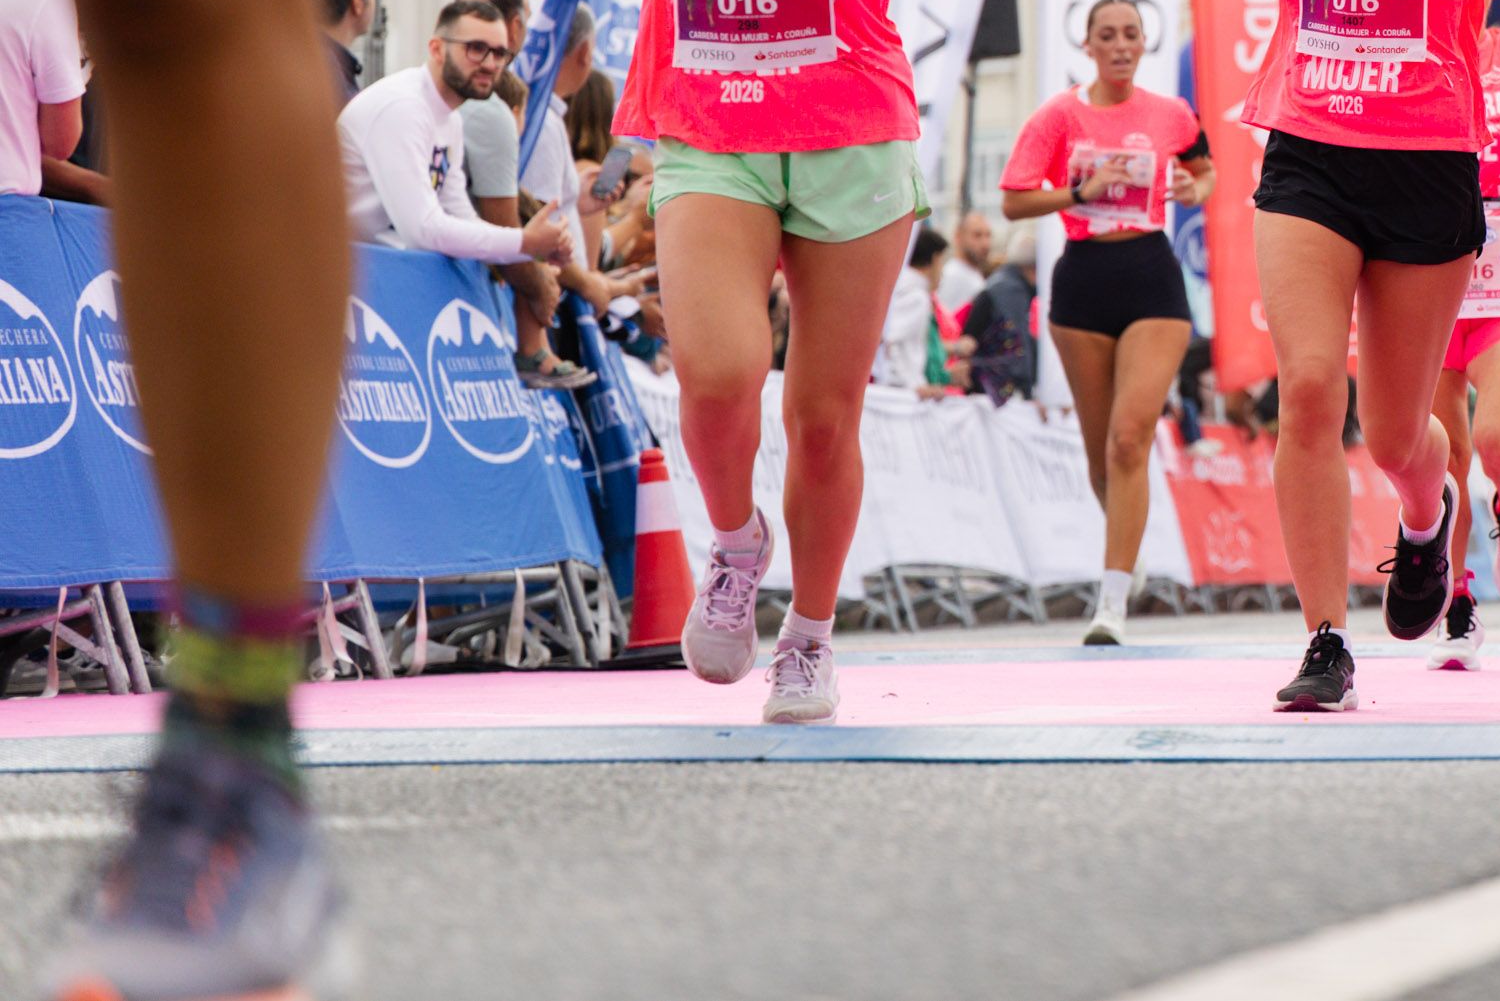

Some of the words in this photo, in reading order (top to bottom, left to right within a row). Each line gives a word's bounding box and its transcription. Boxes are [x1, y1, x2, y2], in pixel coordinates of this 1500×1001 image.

[738, 20, 760, 31] 298
[1341, 15, 1365, 26] 1407
[688, 30, 719, 41] CARRERA
[720, 32, 729, 41] DE
[730, 33, 740, 42] LA
[741, 32, 769, 42] MUJER
[775, 31, 783, 40] A
[783, 27, 817, 39] CORUÑA
[1307, 21, 1329, 33] CARRERA
[1329, 25, 1337, 34] DE
[1337, 27, 1345, 35] LA
[1346, 27, 1370, 36] MUJER
[1375, 28, 1381, 36] A
[1383, 27, 1411, 37] CORUÑA
[1307, 36, 1340, 52] OYSHO
[1366, 45, 1410, 54] Santander
[691, 47, 735, 62] OYSHO
[767, 47, 817, 61] Santander
[1302, 56, 1403, 94] MUJER
[719, 79, 764, 104] 2026
[1327, 94, 1364, 115] 2026
[1472, 263, 1494, 280] 16
[0, 327, 49, 346] ECHERA
[0, 355, 71, 405] IANA
